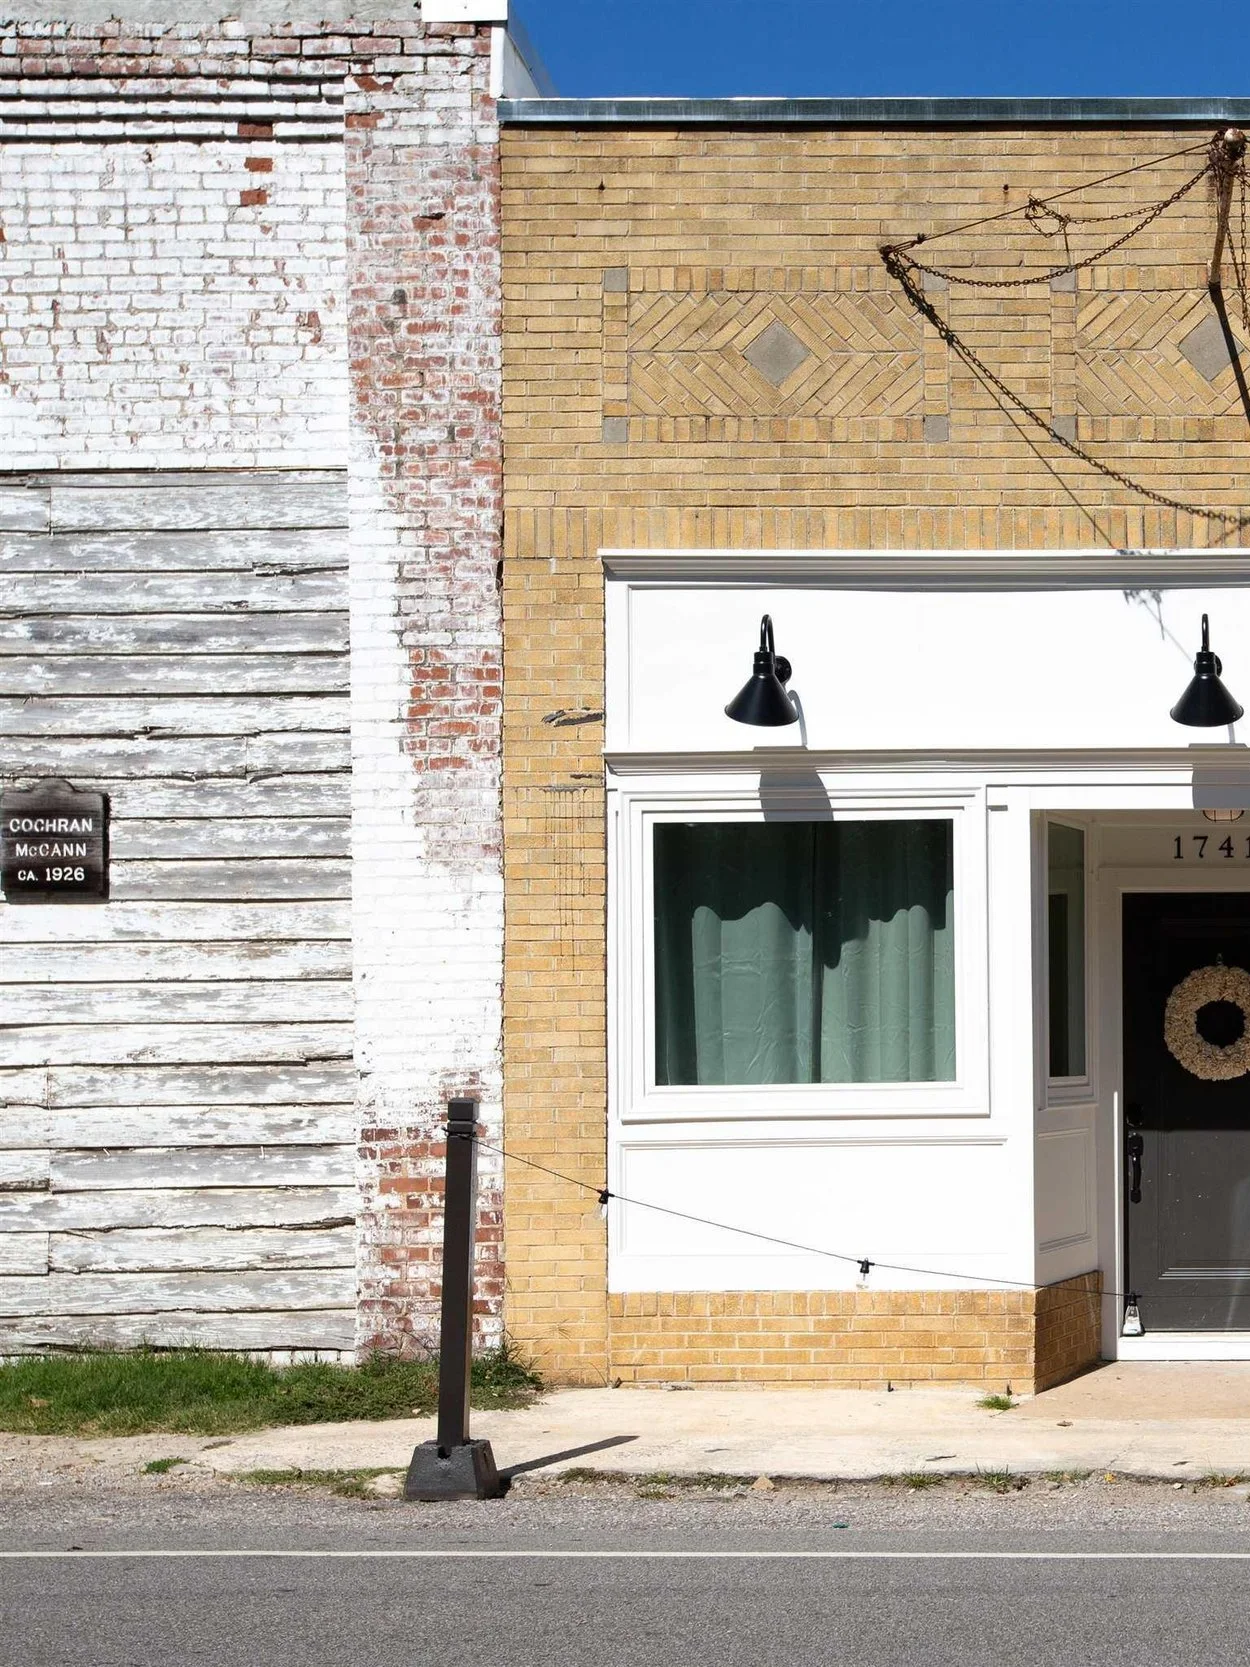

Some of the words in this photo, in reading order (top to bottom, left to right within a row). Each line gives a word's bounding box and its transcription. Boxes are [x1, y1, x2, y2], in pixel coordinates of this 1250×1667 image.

[9, 818, 93, 833] COCHRAN
[15, 843, 87, 857] McCANN
[17, 869, 39, 881] CA.
[45, 867, 85, 881] 1926
